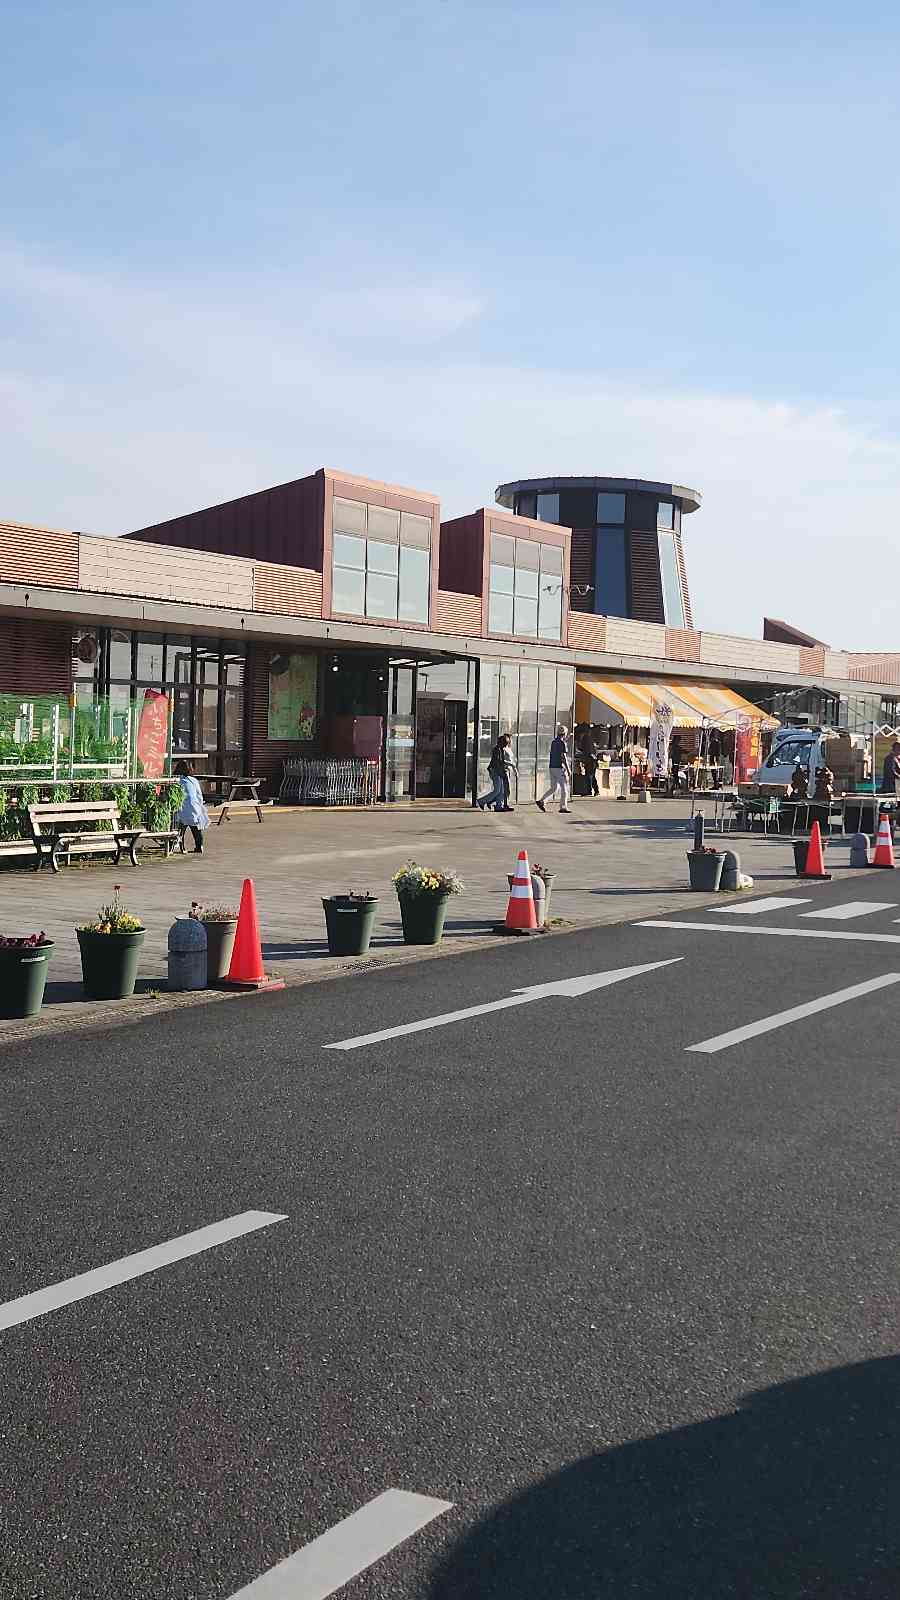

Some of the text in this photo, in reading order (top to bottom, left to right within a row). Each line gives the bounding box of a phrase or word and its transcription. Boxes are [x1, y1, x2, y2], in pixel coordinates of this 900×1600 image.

[144, 702, 164, 778] いちごミル
